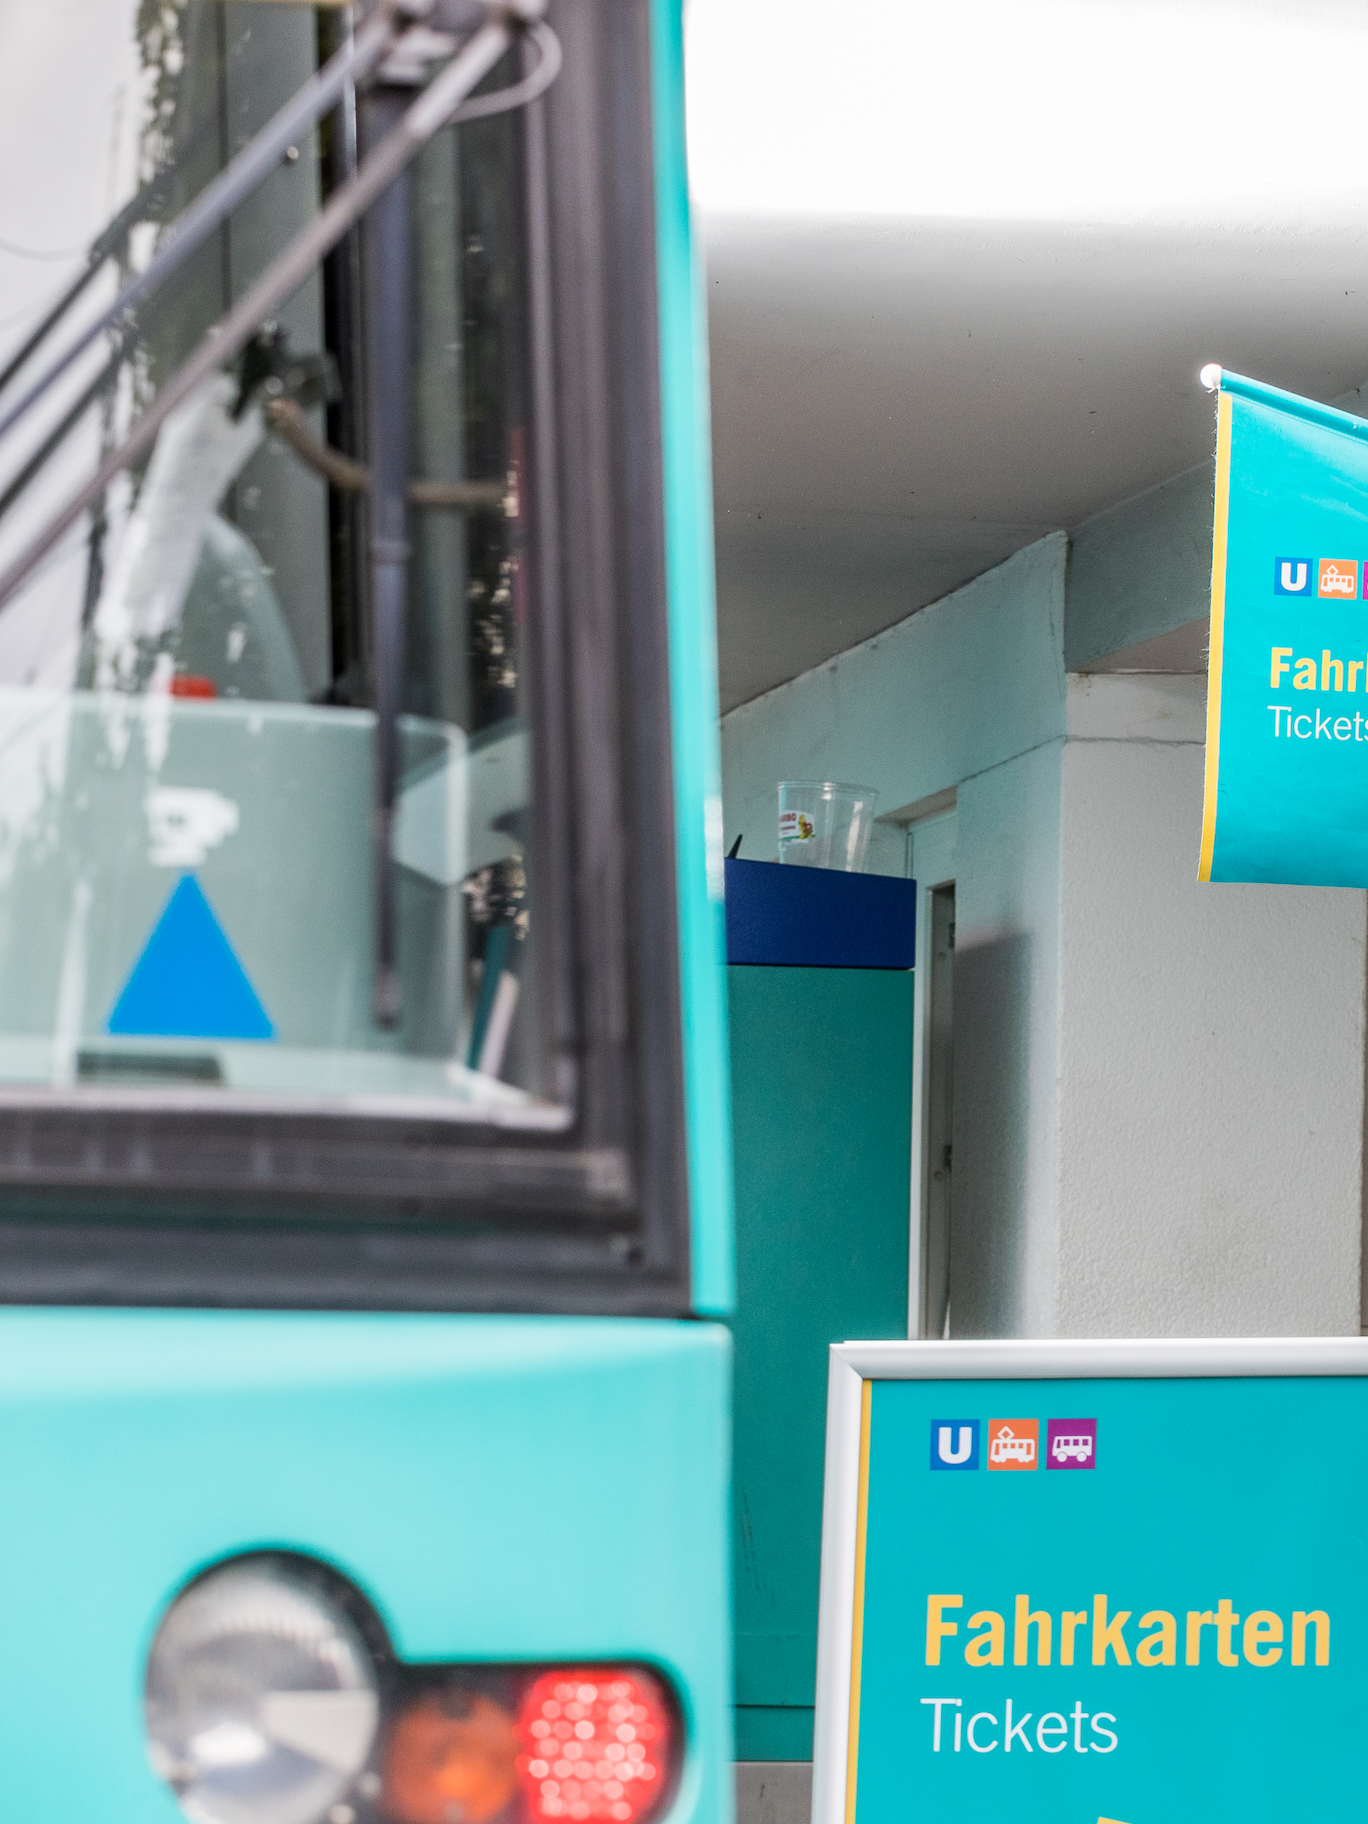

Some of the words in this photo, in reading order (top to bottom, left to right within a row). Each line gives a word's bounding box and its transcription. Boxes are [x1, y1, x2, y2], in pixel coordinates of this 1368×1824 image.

[1281, 561, 1307, 592] U
[938, 1426, 972, 1465] U
[925, 1594, 1331, 1667] Fahrkarten
[919, 1697, 1119, 1754] Tickets
